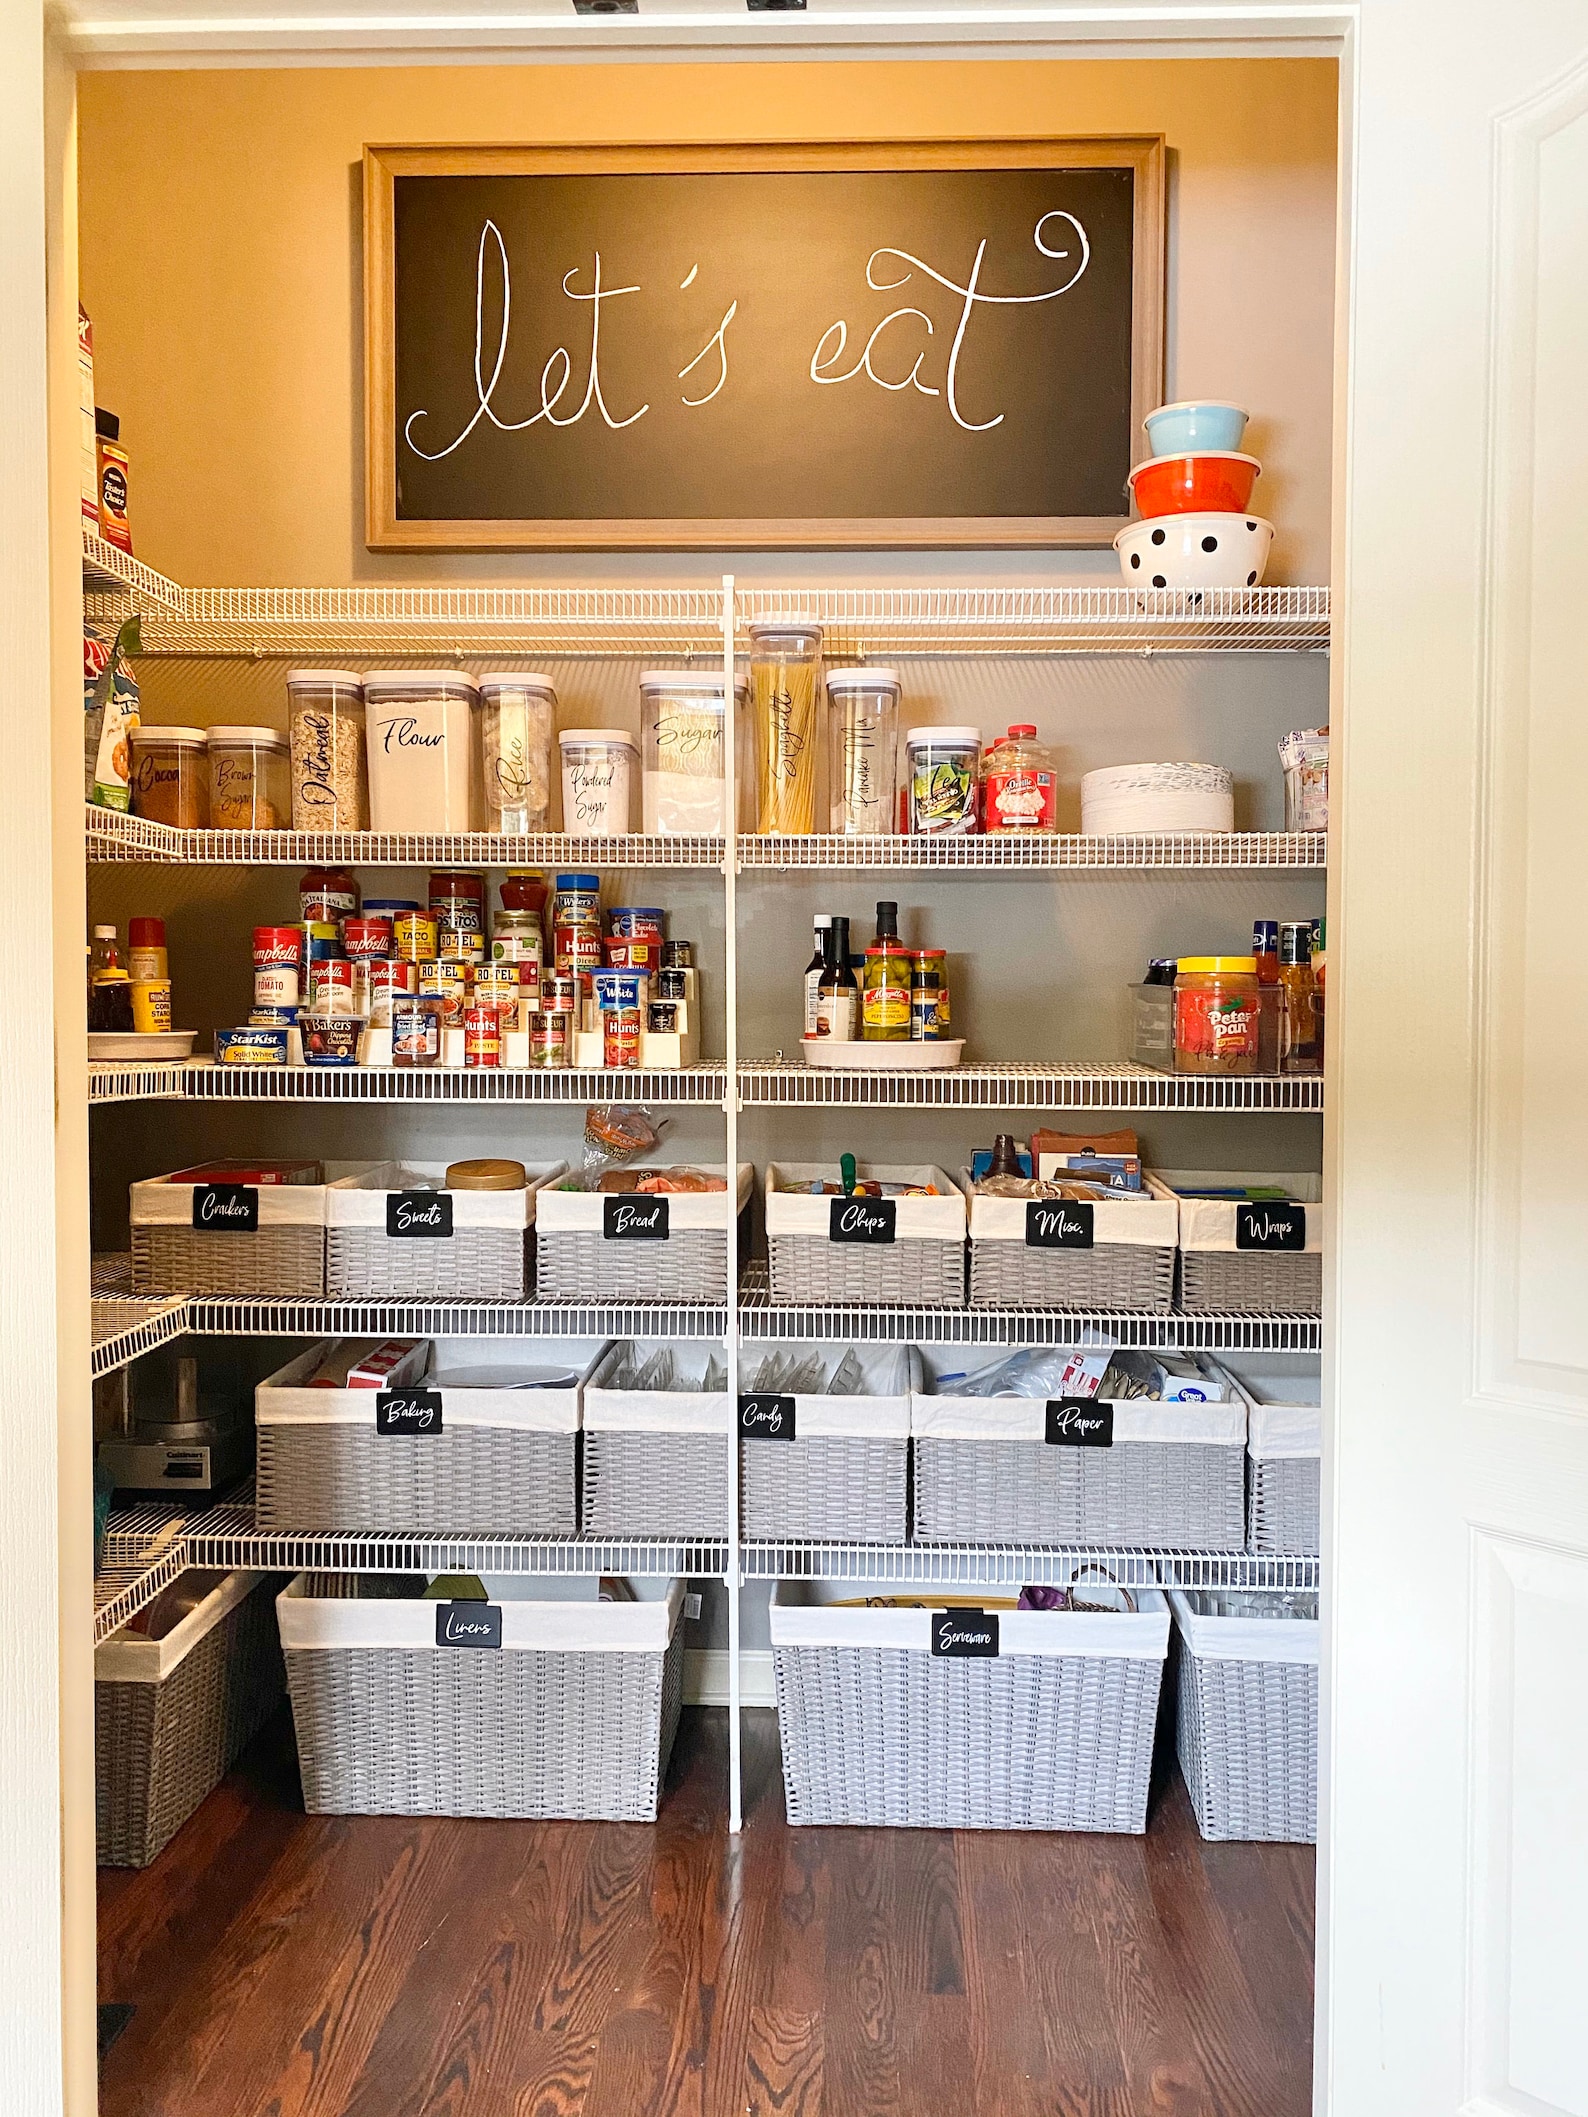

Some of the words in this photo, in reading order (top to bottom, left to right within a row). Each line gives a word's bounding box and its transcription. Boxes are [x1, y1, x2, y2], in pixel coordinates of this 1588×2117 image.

[406, 218, 737, 460] let's
[809, 210, 1090, 431] eat
[104, 491, 125, 507] Choice
[377, 717, 445, 753] Flour
[653, 717, 723, 753] Sugar
[768, 688, 804, 780] Spaghetti
[138, 755, 180, 792] Cocoa
[215, 759, 255, 787] Brown
[301, 715, 338, 805] Oatmeal
[496, 737, 531, 799] Rice
[571, 764, 615, 793] Powdered
[931, 762, 964, 799] Tea
[221, 782, 253, 819] Sugar
[575, 791, 607, 826] Sugar
[402, 932, 429, 941] TACO
[258, 981, 284, 991] TOMATO
[606, 987, 634, 998] White
[1207, 1011, 1252, 1025] Peter
[1213, 1023, 1248, 1039] Pan
[230, 1034, 278, 1045] StarKist
[201, 1191, 250, 1221] Crackers
[396, 1200, 442, 1230] Sweets
[612, 1205, 661, 1233] Bread
[840, 1204, 887, 1235] Chips
[1245, 1212, 1293, 1241] Wraps
[382, 1400, 435, 1428] Baking
[742, 1402, 783, 1433] Candy
[1056, 1406, 1104, 1436] Paper
[444, 1612, 492, 1640] Linens
[939, 1621, 992, 1650] Serveware
